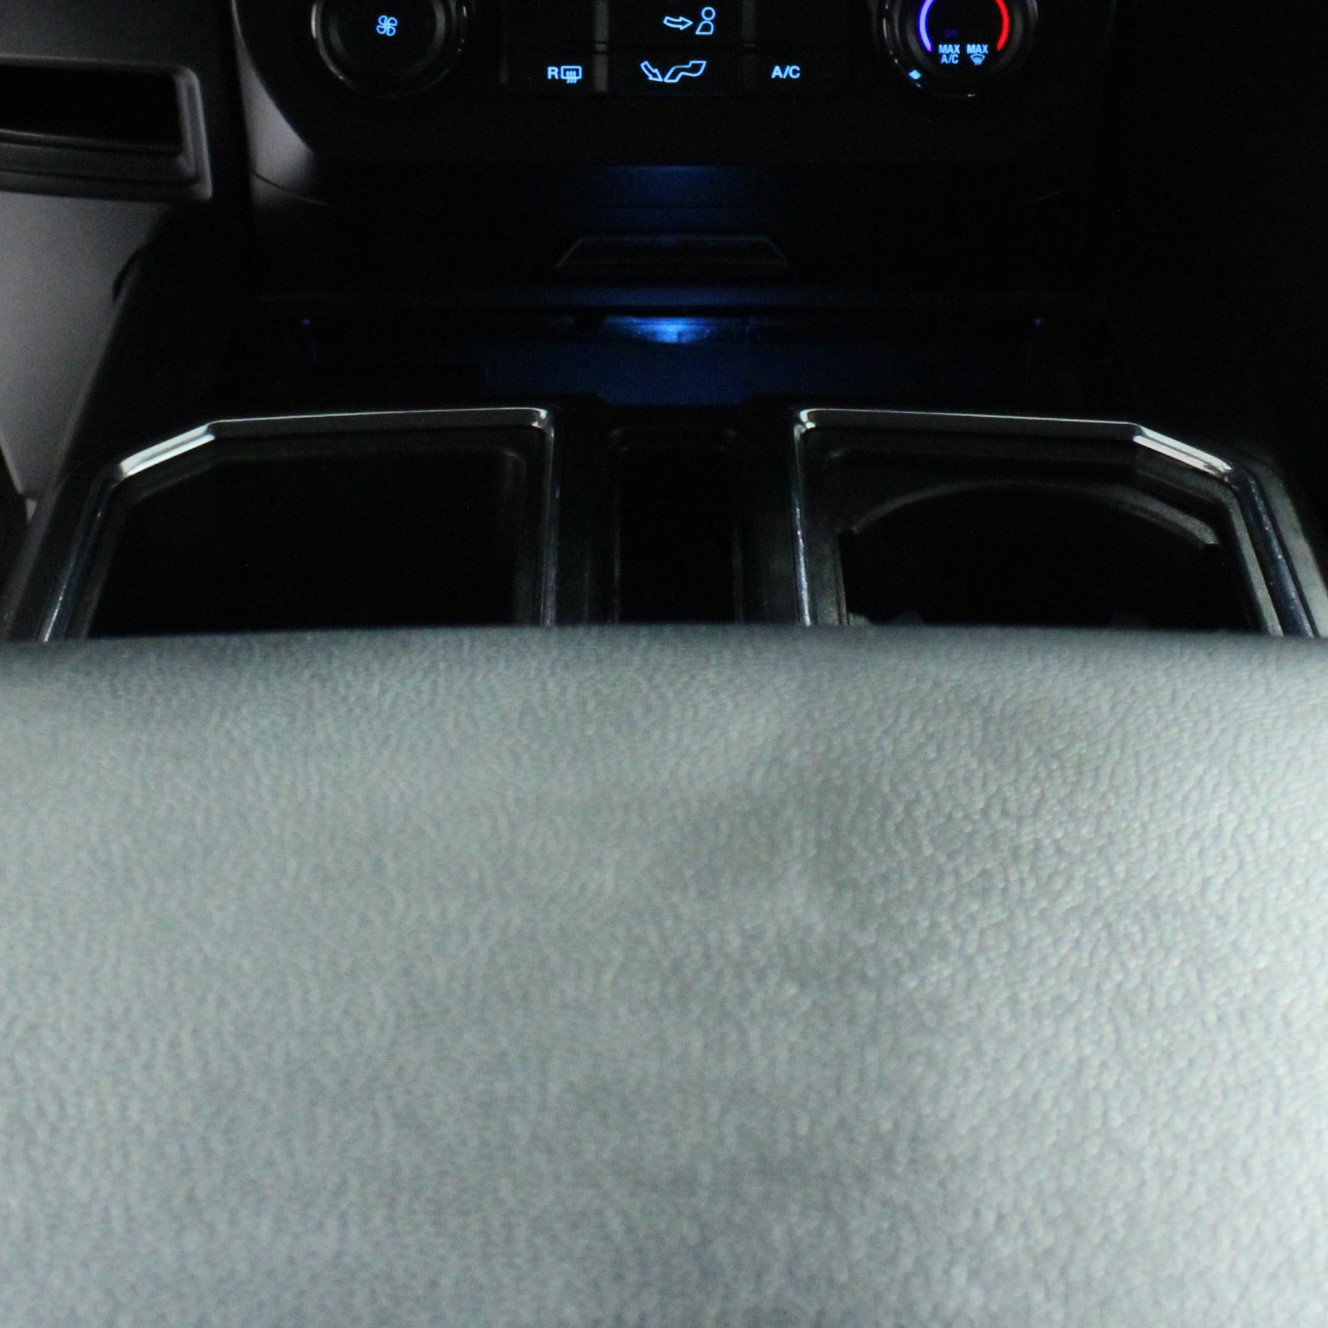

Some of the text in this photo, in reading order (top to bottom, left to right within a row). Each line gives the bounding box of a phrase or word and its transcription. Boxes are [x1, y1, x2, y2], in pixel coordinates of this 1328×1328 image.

[938, 43, 961, 54] MAX
[966, 43, 989, 54] MAX
[940, 54, 959, 65] A/C
[770, 65, 801, 79] A/C
